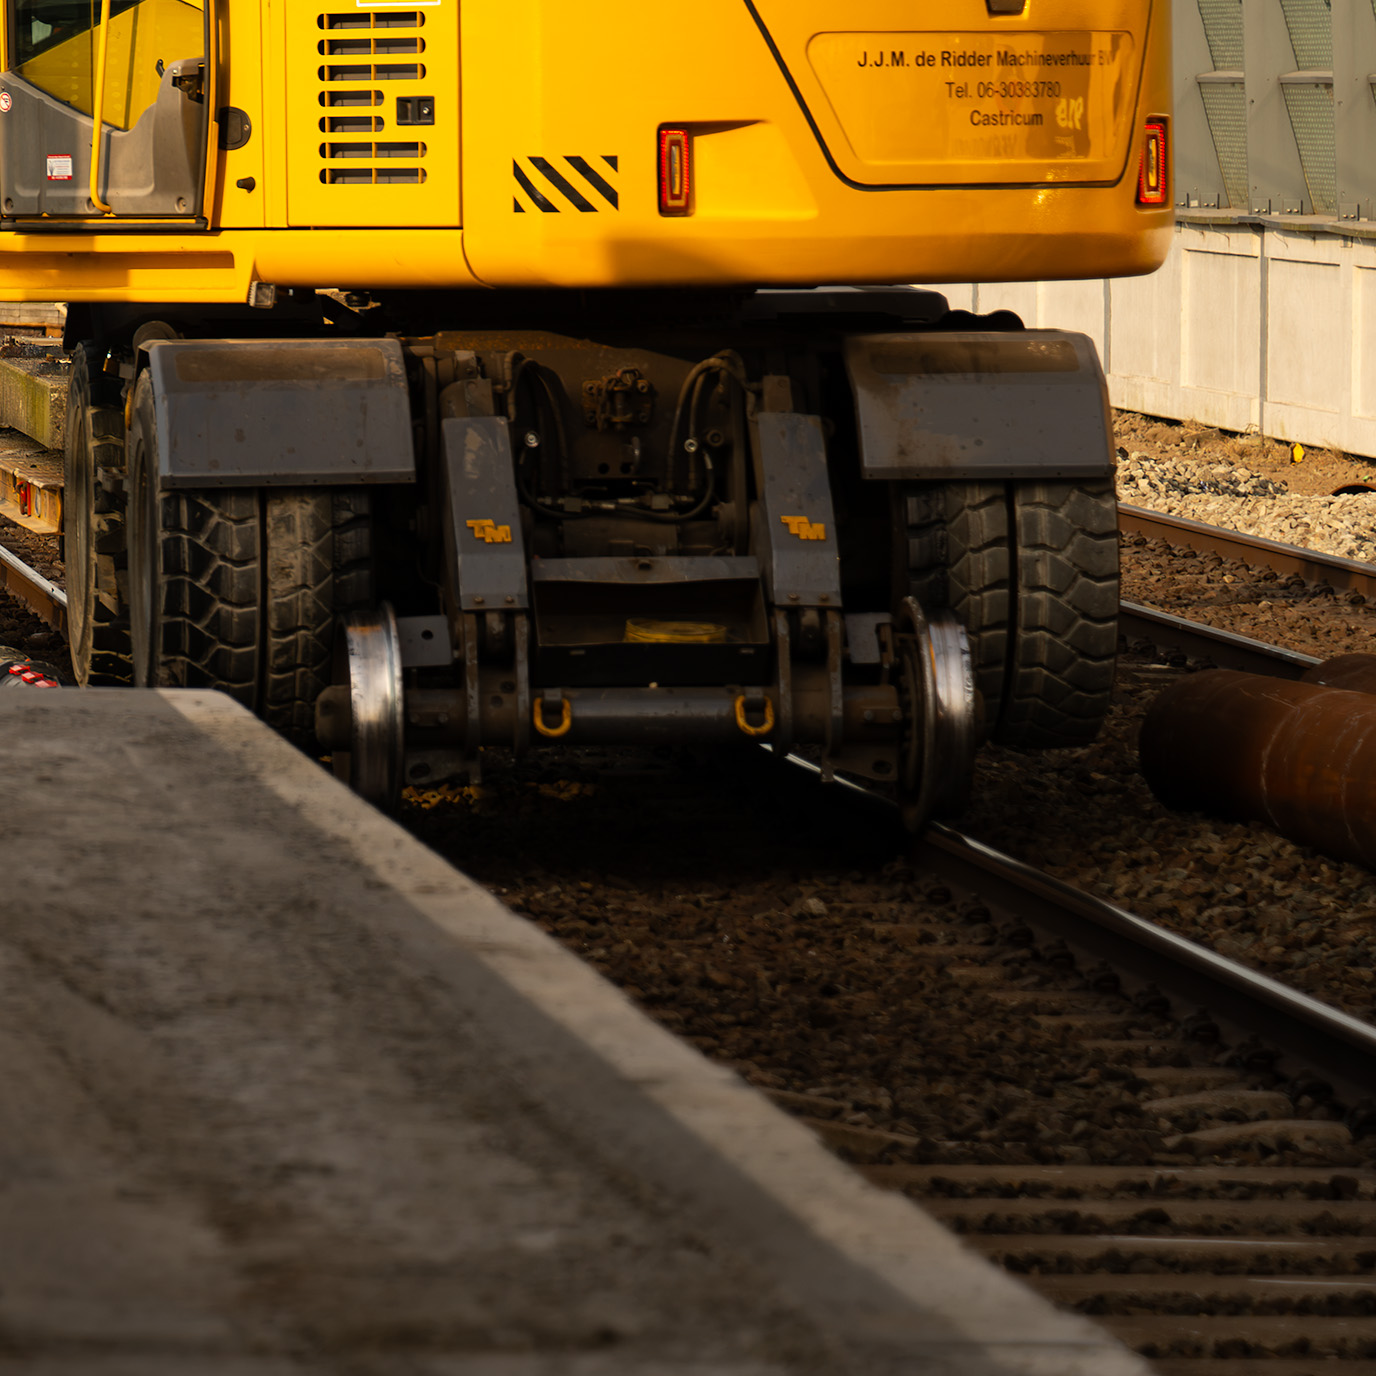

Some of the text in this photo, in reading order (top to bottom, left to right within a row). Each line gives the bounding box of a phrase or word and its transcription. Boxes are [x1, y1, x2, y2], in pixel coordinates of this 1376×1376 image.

[857, 51, 910, 67] J.J.M.
[915, 51, 936, 67] de
[941, 50, 993, 67] Ridder
[996, 50, 1096, 67] Machineverhuur
[945, 81, 1061, 98] Tel. 06-30383780
[970, 109, 1044, 126] Castricum
[780, 515, 826, 541] TM
